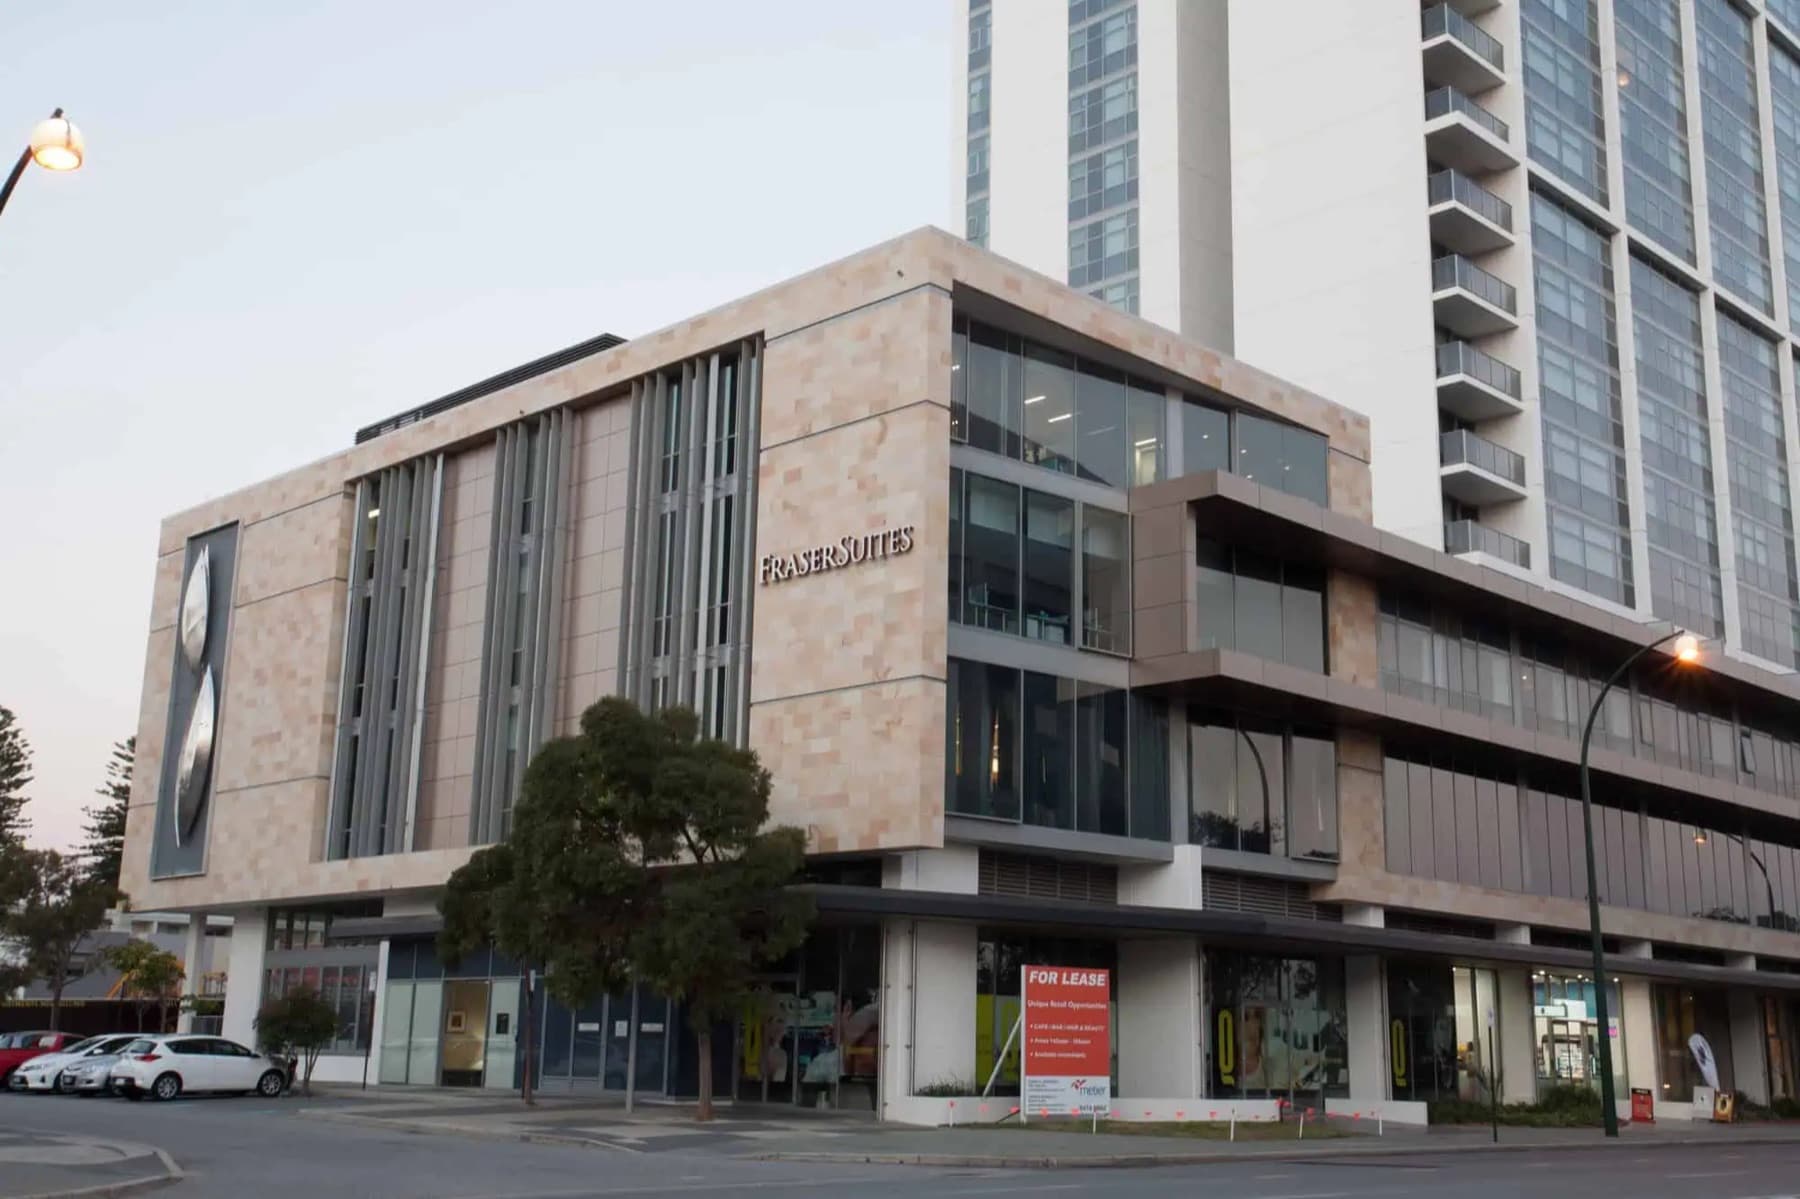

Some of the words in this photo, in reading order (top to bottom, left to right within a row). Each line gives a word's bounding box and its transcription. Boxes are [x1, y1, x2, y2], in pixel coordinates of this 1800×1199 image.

[1029, 970, 1058, 985] FOR
[1061, 972, 1106, 987] LEASE
[1027, 1000, 1049, 1009] Unique
